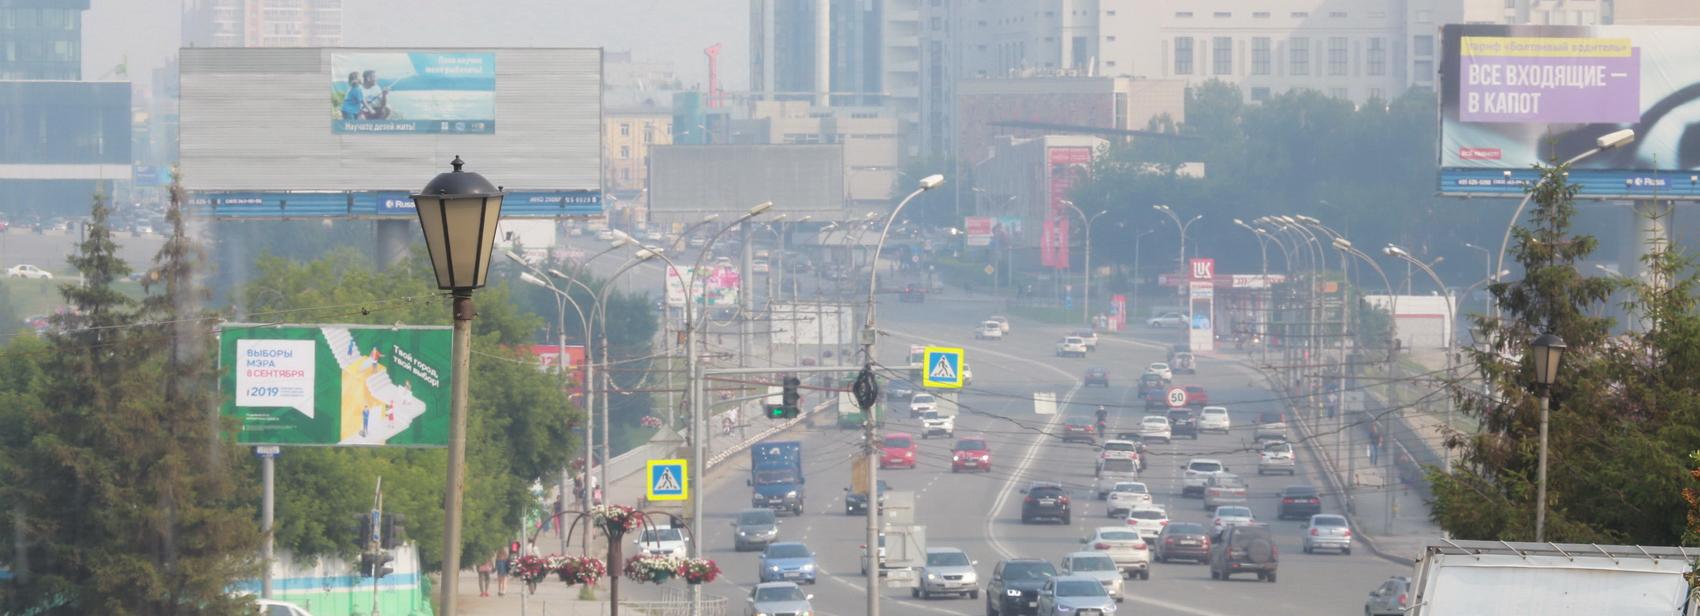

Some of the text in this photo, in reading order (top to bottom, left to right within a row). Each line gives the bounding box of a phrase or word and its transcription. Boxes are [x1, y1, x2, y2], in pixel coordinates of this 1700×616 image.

[1468, 64, 1502, 86] ВСЕ
[1506, 64, 1607, 88] ВХОДЯЩИЕ
[1468, 92, 1541, 113] В КАПОТ
[246, 349, 293, 358] ВЫБОРЫ
[393, 344, 413, 363] Твой
[246, 359, 275, 367] МЭРА
[246, 369, 305, 378] 8 СЕНТЯБРЯ
[393, 355, 439, 388] твой выбор!
[251, 386, 279, 397] 2019
[1171, 392, 1184, 402] 50
